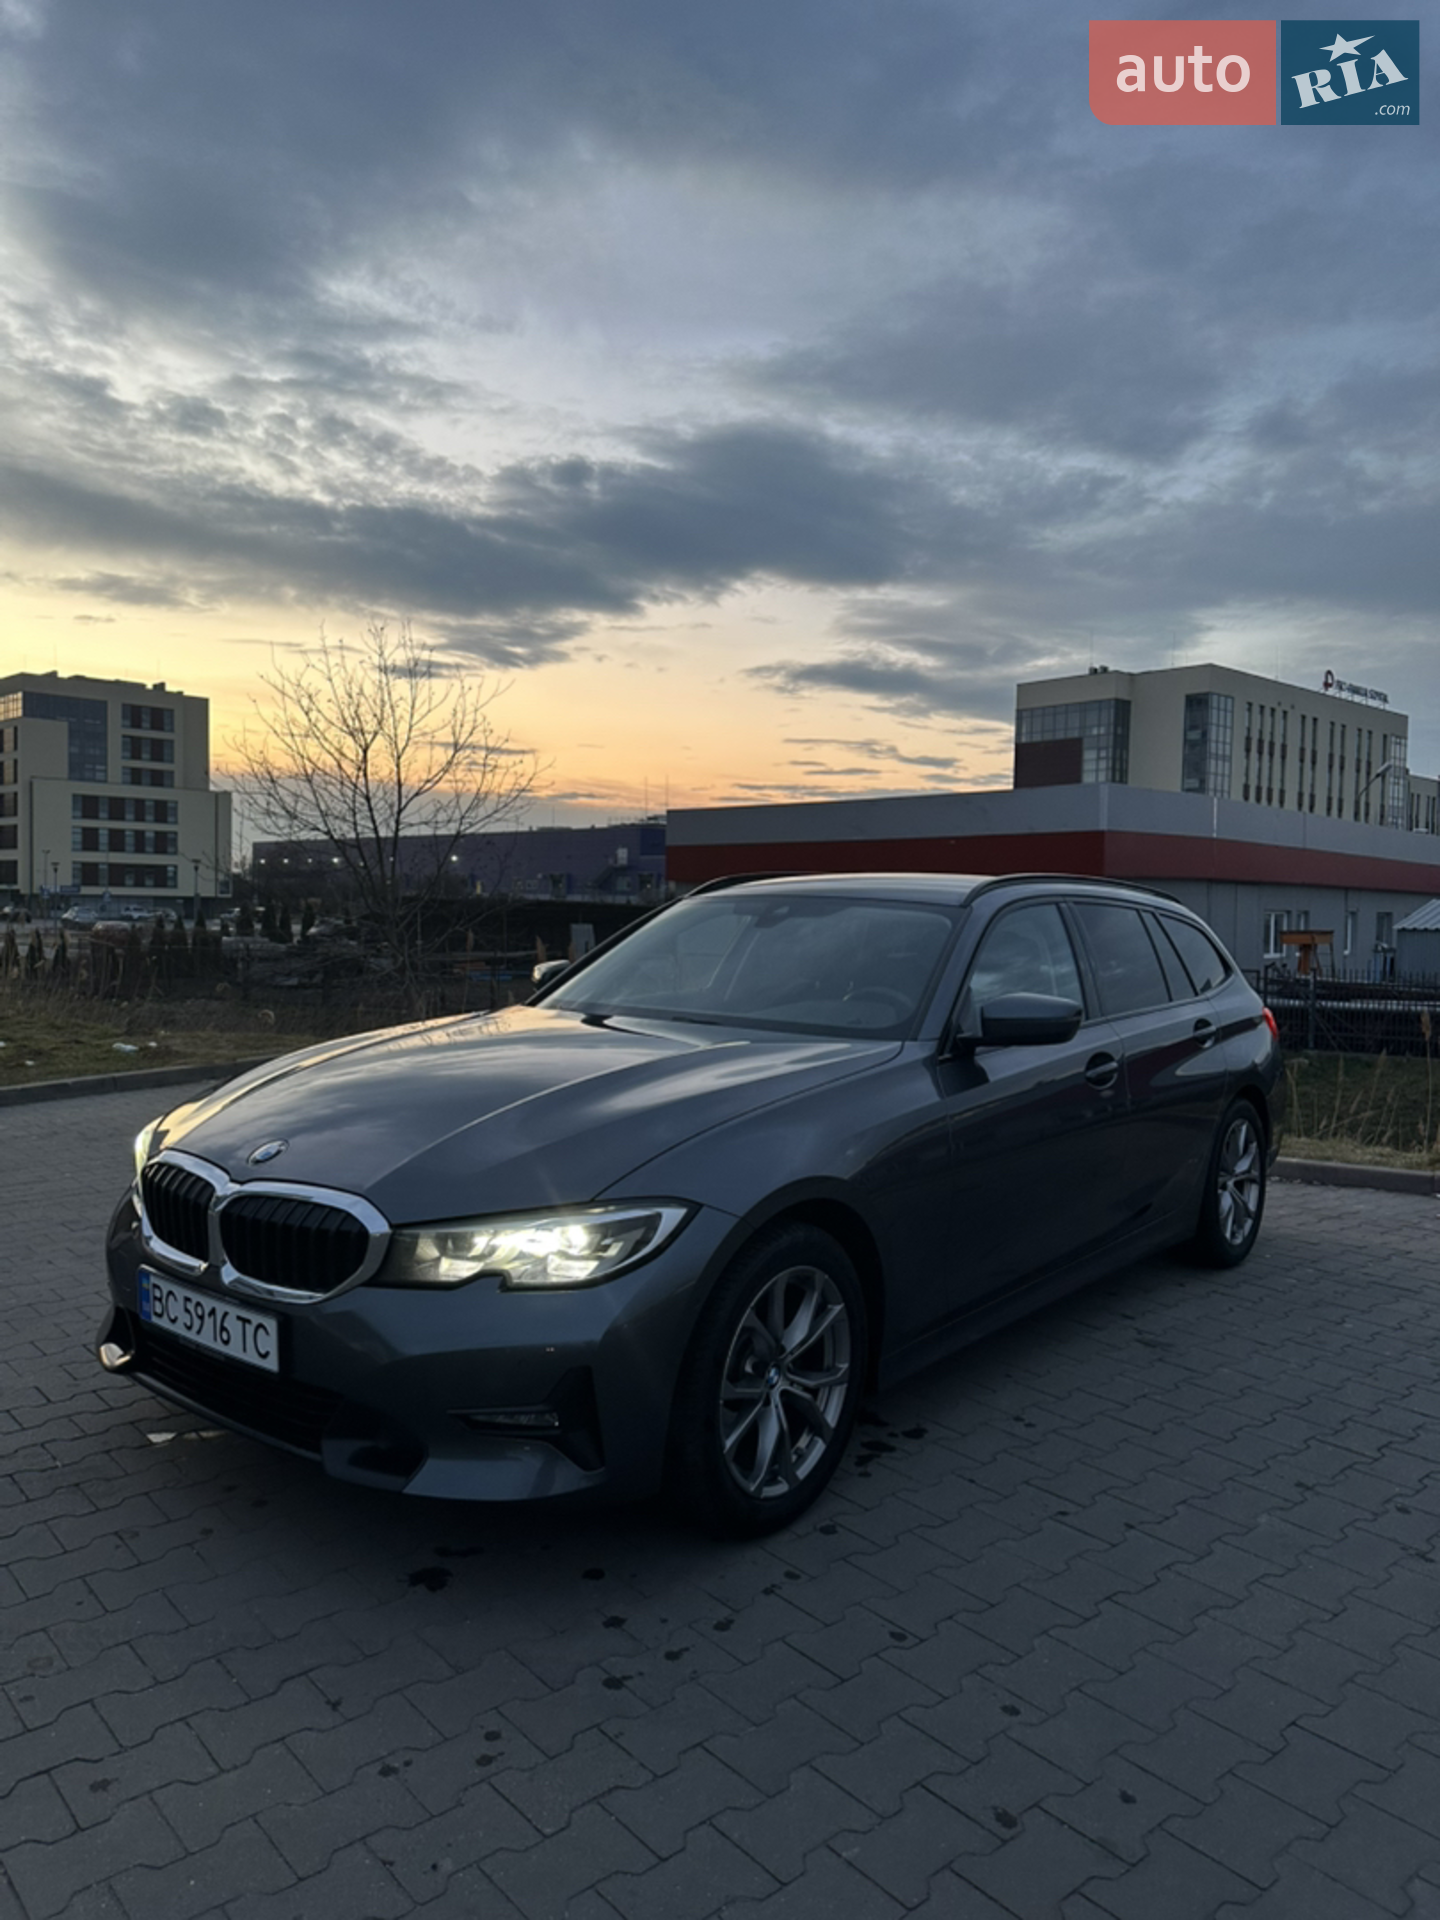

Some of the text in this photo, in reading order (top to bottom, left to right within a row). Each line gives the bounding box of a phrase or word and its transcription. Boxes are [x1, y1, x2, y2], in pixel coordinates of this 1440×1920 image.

[152, 1282, 269, 1359] BC 5916 TC
